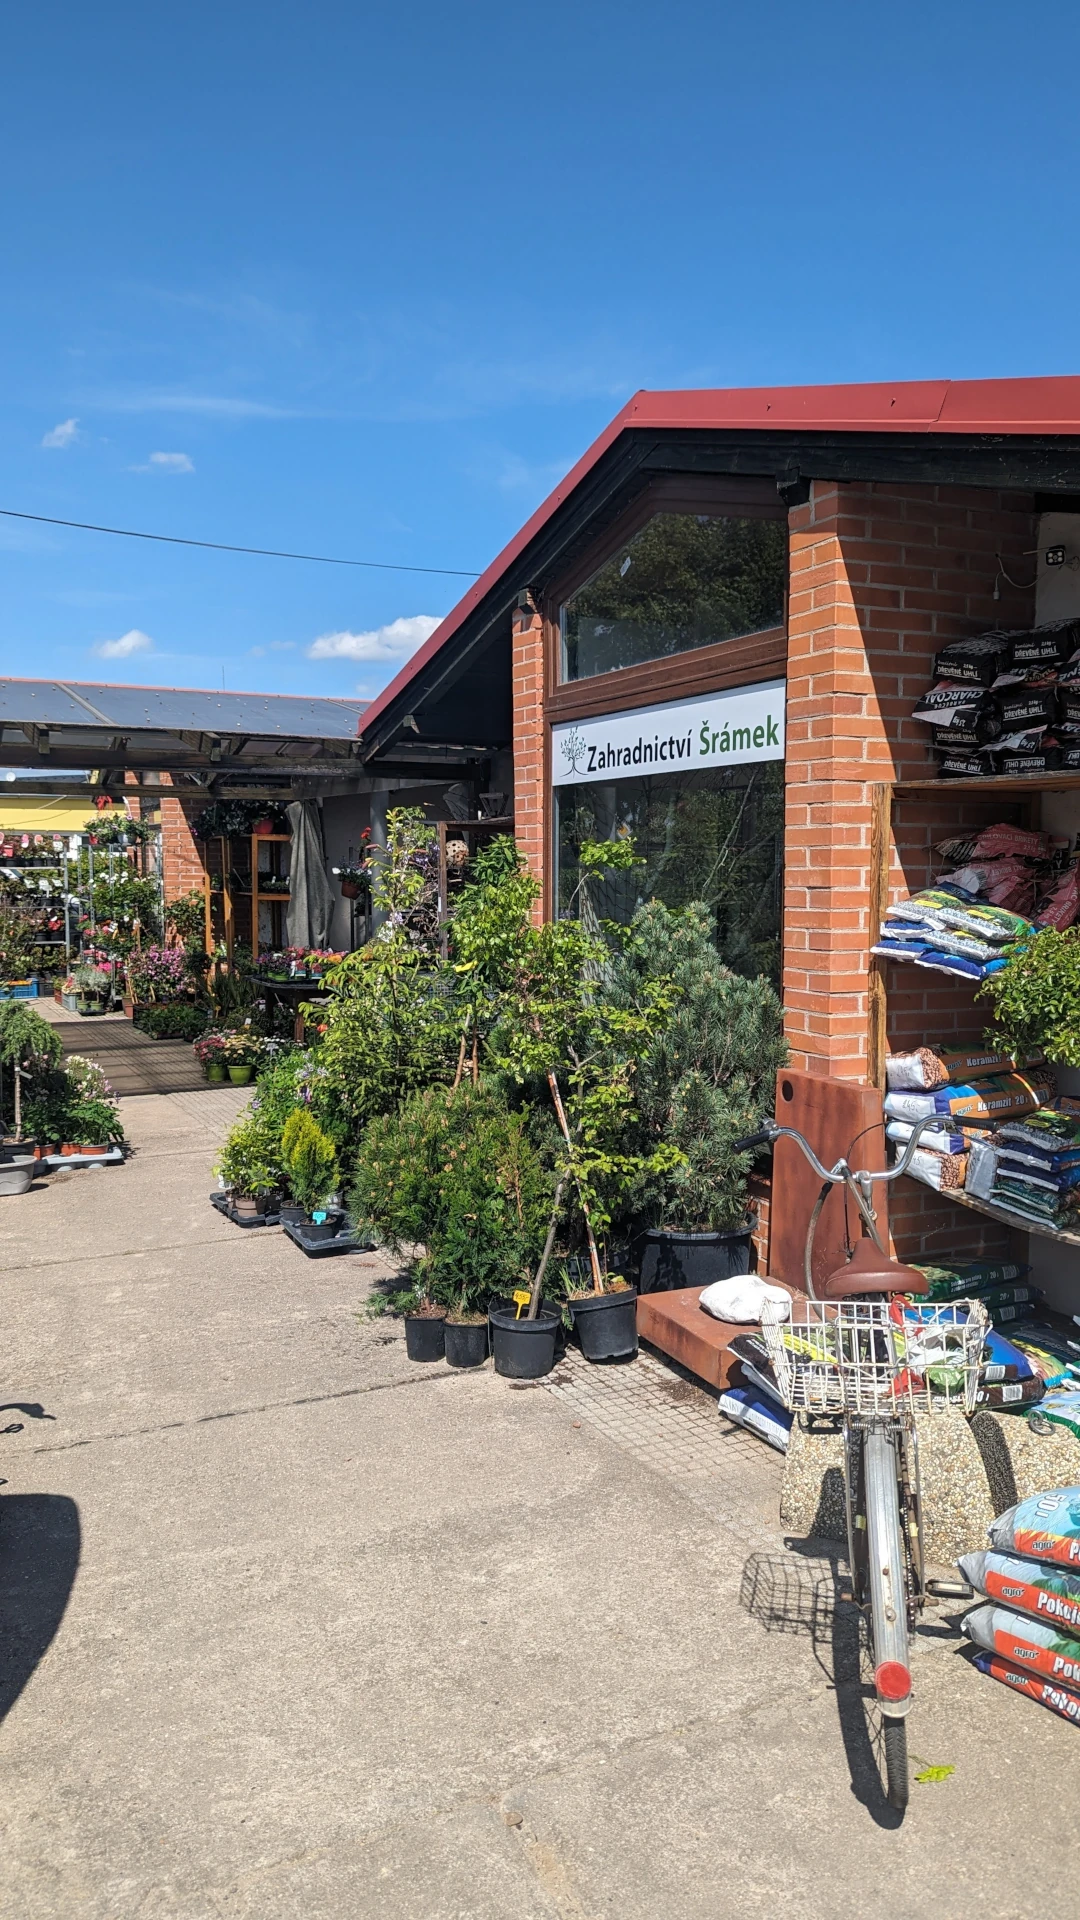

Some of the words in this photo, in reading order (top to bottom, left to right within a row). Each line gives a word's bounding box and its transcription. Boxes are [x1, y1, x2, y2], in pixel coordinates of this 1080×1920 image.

[1015, 648, 1040, 657] DŘEVĚNÉ
[1041, 645, 1057, 655] UHLÍ
[938, 666, 961, 675] DŘEVĚNÉ
[926, 692, 983, 703] CHARCOAL
[1004, 707, 1028, 718] DŘEVĚNÉ
[1029, 705, 1043, 714] UHLÍ
[587, 729, 692, 773] Zahradnictví
[700, 715, 779, 756] Šrámek
[944, 760, 967, 769] DŘEVĚNÉ
[968, 764, 981, 772] UHLÍ
[966, 1055, 1002, 1067] Keramzit
[978, 1098, 1012, 1112] Keramzit
[1015, 1095, 1024, 1105] 20
[1032, 1541, 1054, 1551] agro
[1069, 1542, 1080, 1561] P
[1002, 1586, 1023, 1597] agro
[1014, 1647, 1037, 1659] agro
[1006, 1672, 1028, 1684] agro
